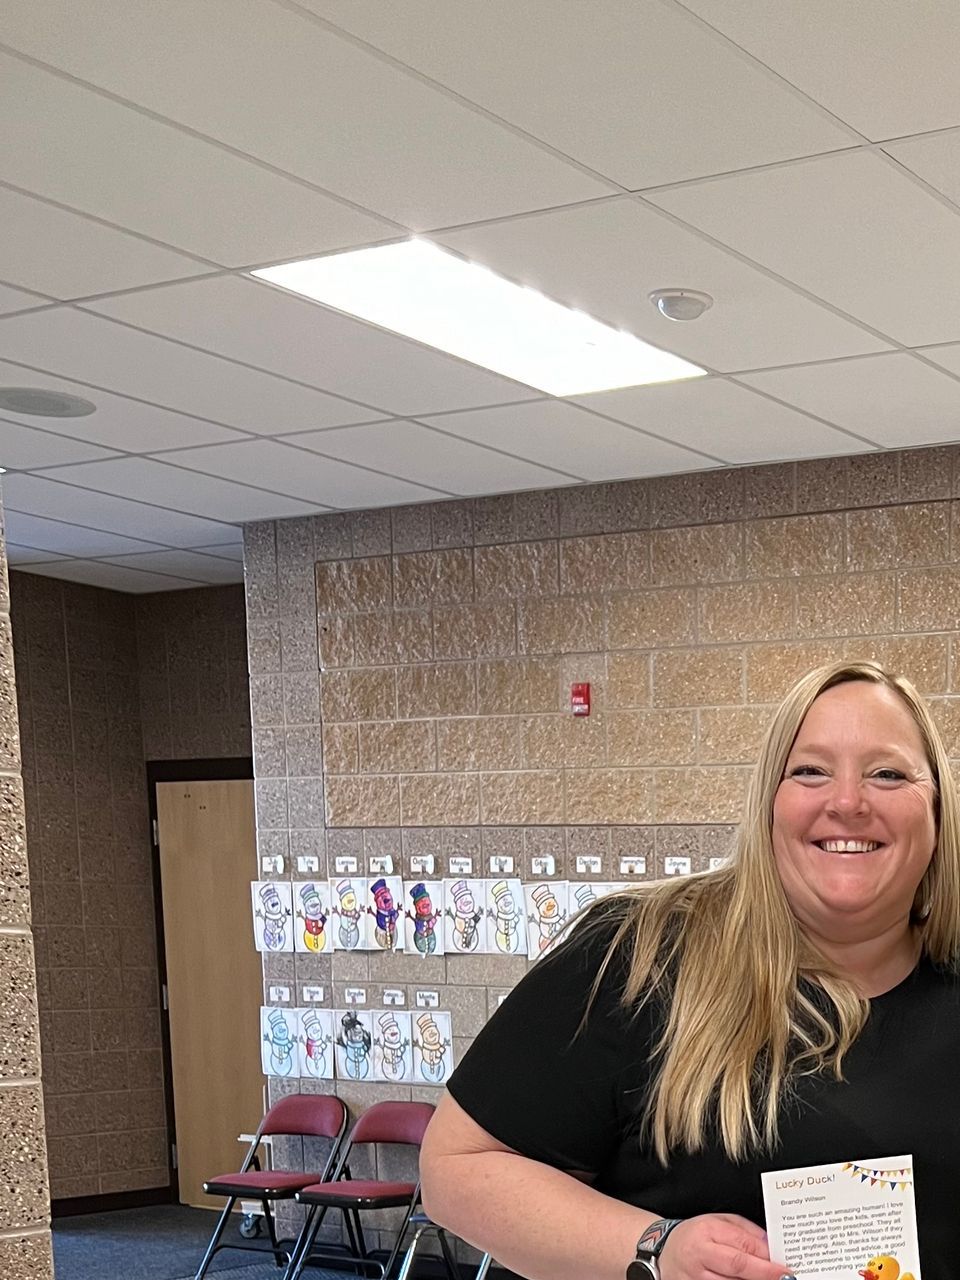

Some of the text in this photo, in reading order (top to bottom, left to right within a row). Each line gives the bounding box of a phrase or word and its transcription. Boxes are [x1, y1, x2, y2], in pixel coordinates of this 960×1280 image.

[776, 1174, 835, 1189] Lucky Duck!
[834, 1207, 860, 1215] amazing
[798, 1228, 826, 1236] graduate
